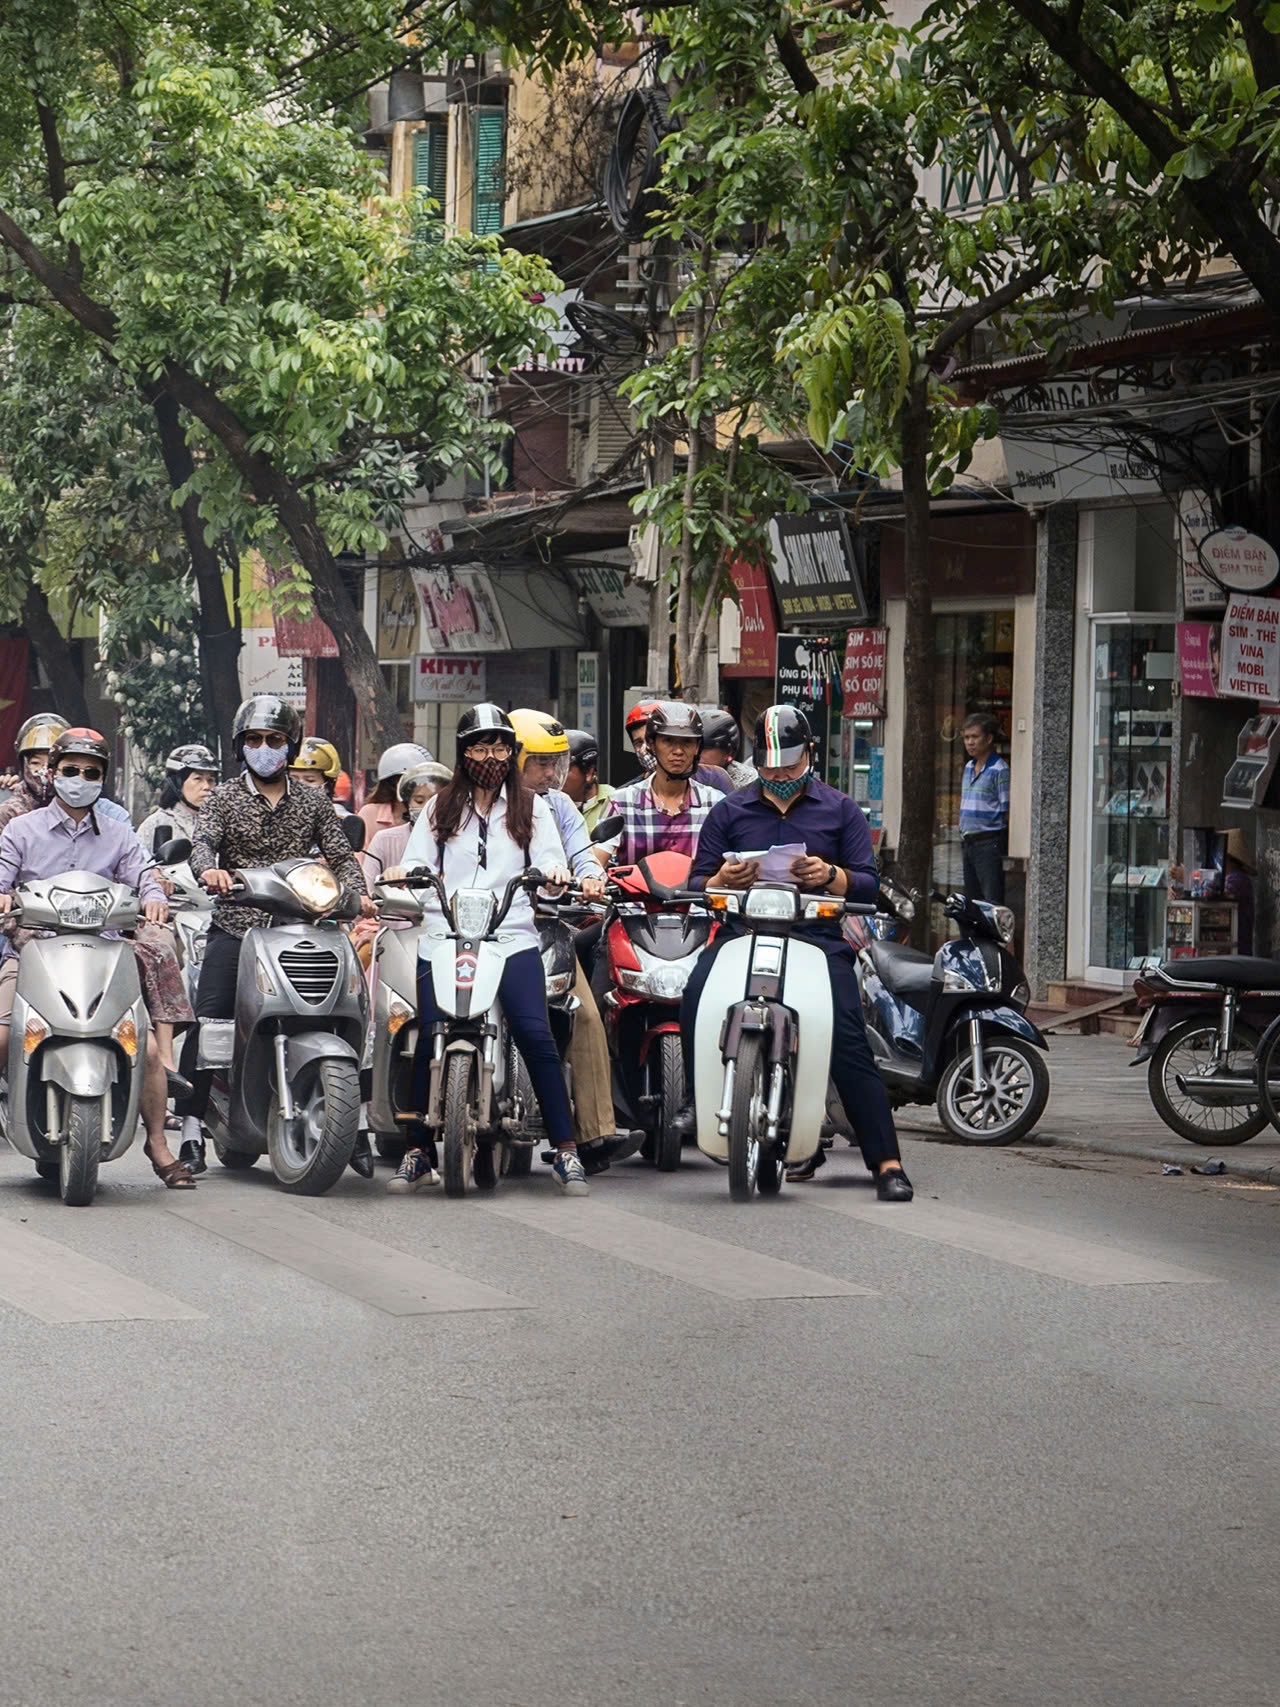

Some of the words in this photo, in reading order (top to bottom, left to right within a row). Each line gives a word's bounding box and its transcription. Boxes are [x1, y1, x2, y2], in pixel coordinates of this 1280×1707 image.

[783, 533, 821, 586] SMART
[811, 530, 851, 583] PHONE
[1219, 563, 1240, 575] SIM
[1229, 596, 1256, 621] ĐIỂM
[1256, 605, 1280, 625] BÁN
[848, 630, 864, 647] SIM
[1228, 625, 1249, 639] SIM
[1240, 643, 1264, 659] VINA
[420, 658, 481, 676] KITTY
[845, 656, 860, 669] SIM
[1237, 661, 1264, 677] MOBI
[782, 686, 801, 697] PHỤ
[1229, 678, 1271, 696] VIETTEL
